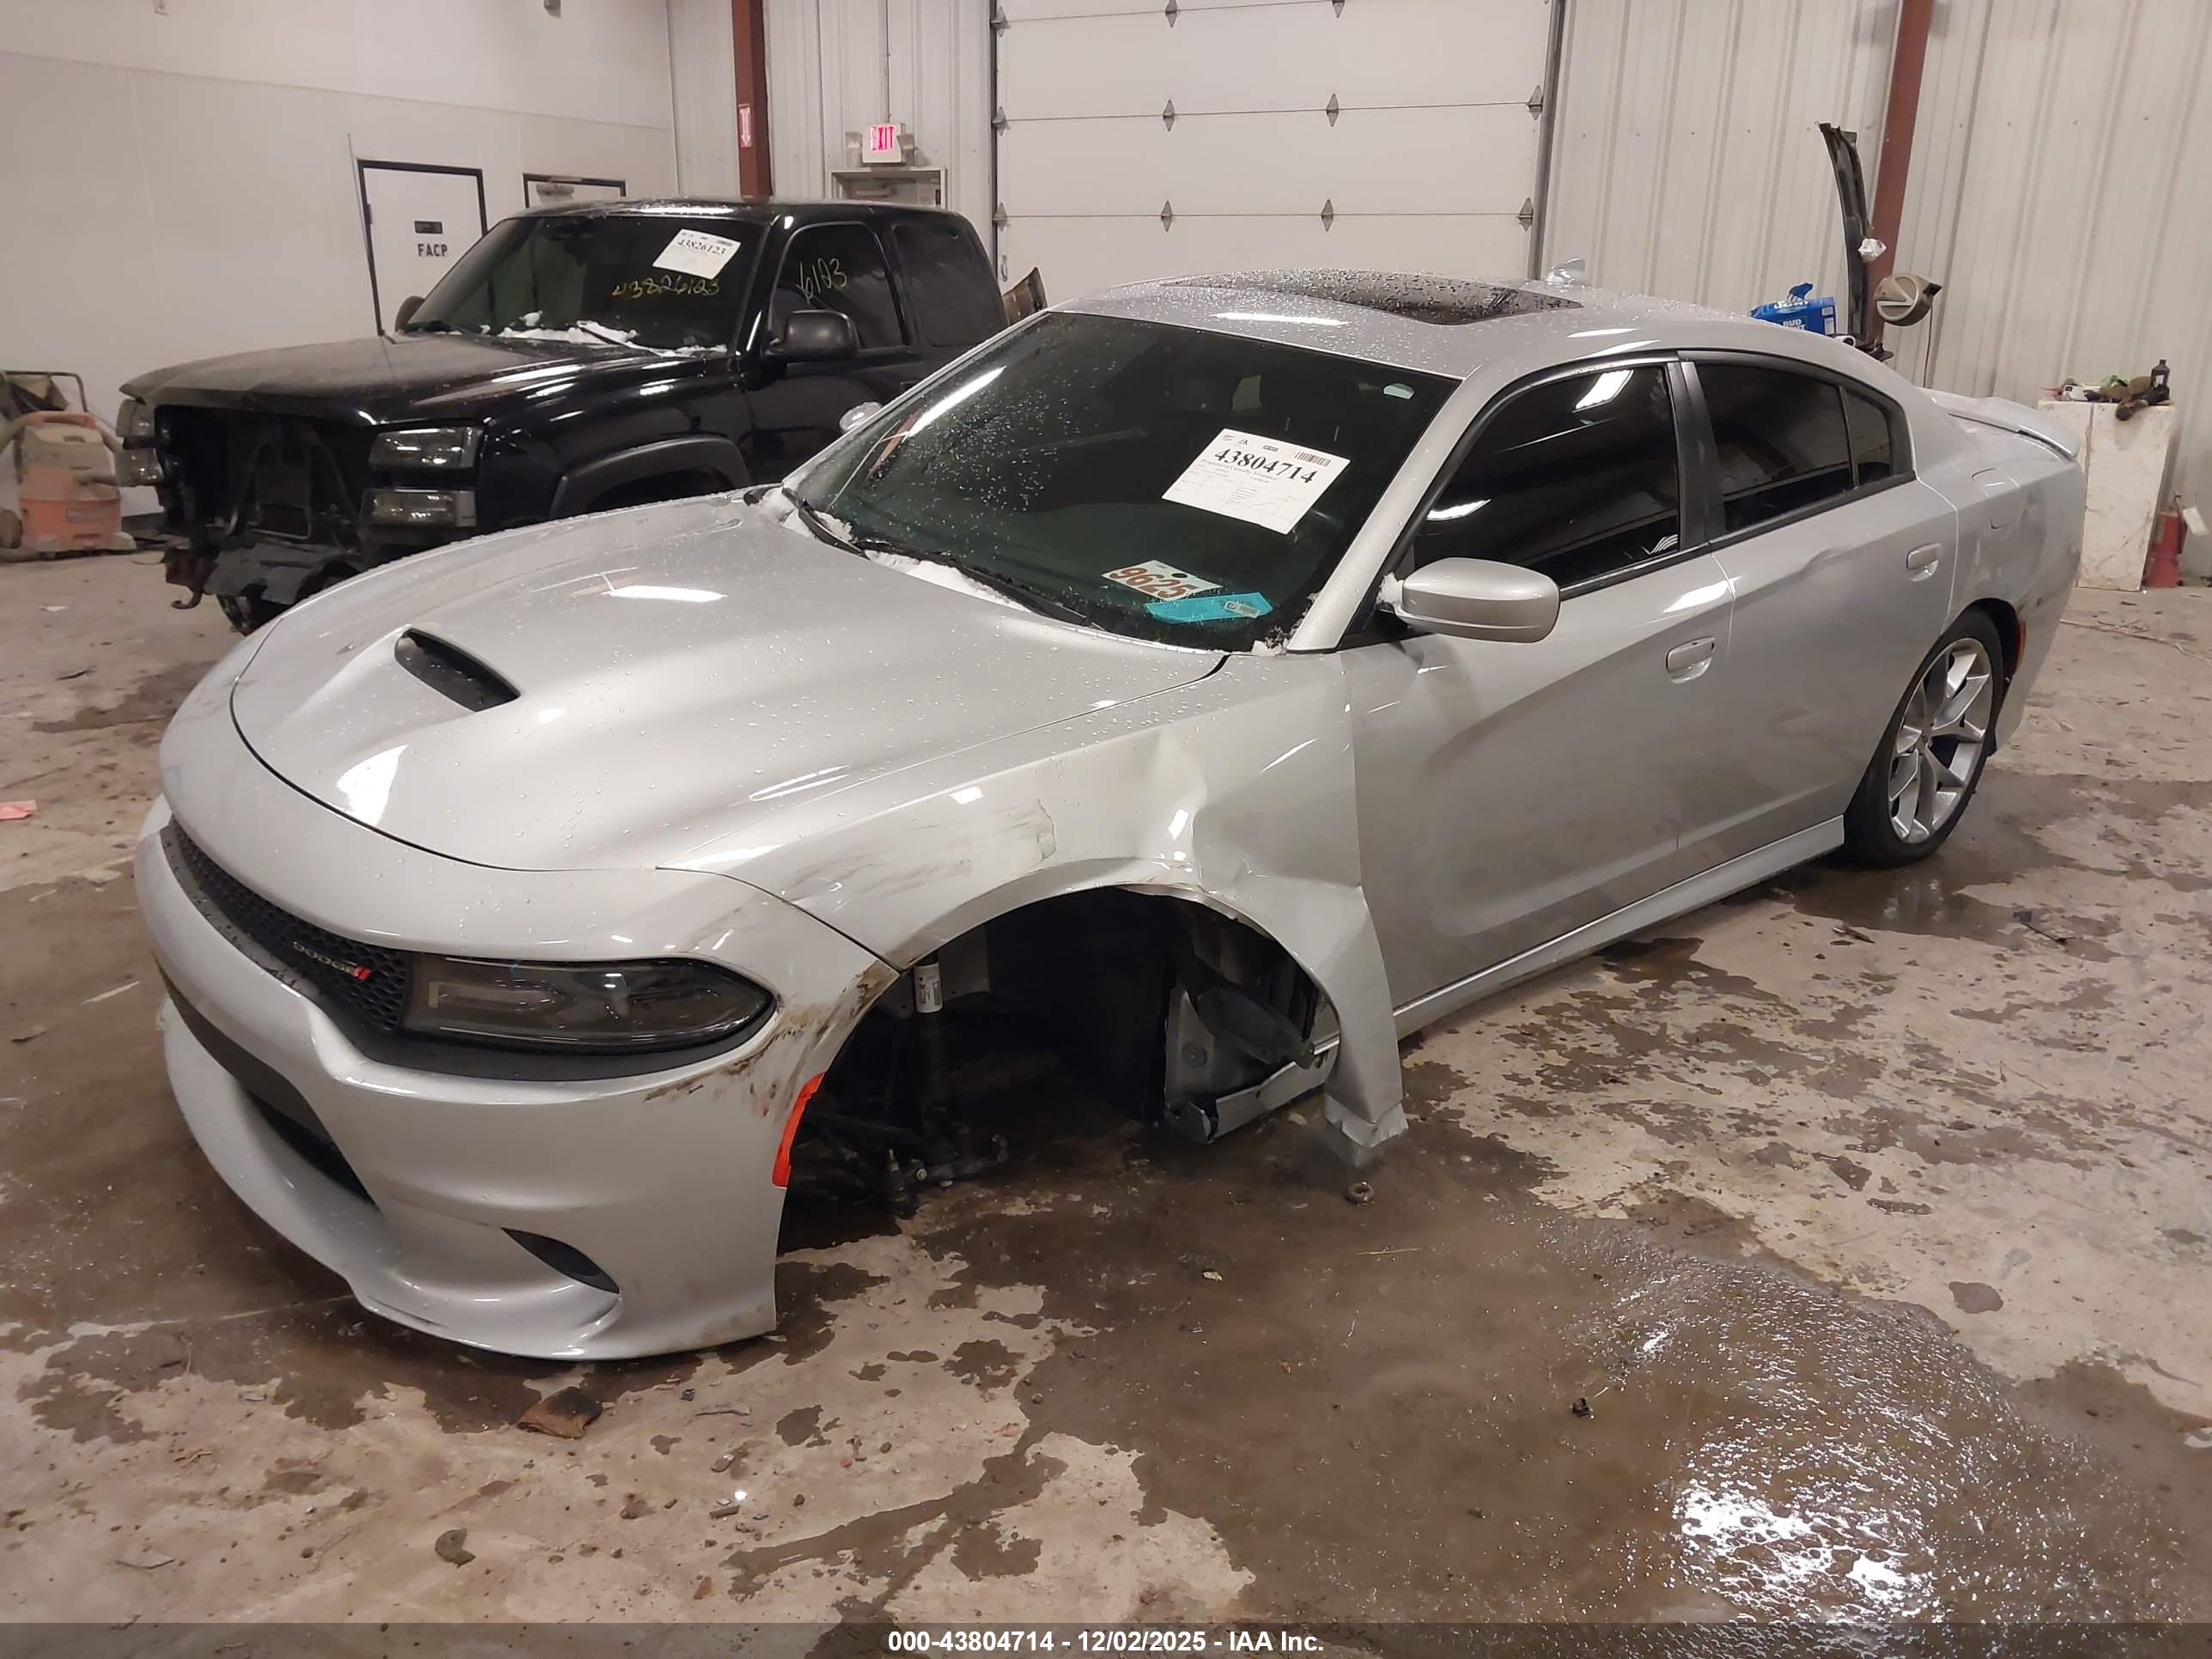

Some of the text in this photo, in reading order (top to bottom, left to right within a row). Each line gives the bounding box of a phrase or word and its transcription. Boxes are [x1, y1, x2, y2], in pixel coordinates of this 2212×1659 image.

[870, 125, 895, 151] EXIT
[417, 243, 447, 257] FACP
[678, 239, 726, 256] 43826123
[1214, 447, 1318, 483] 43804714
[1109, 567, 1200, 599] 9625
